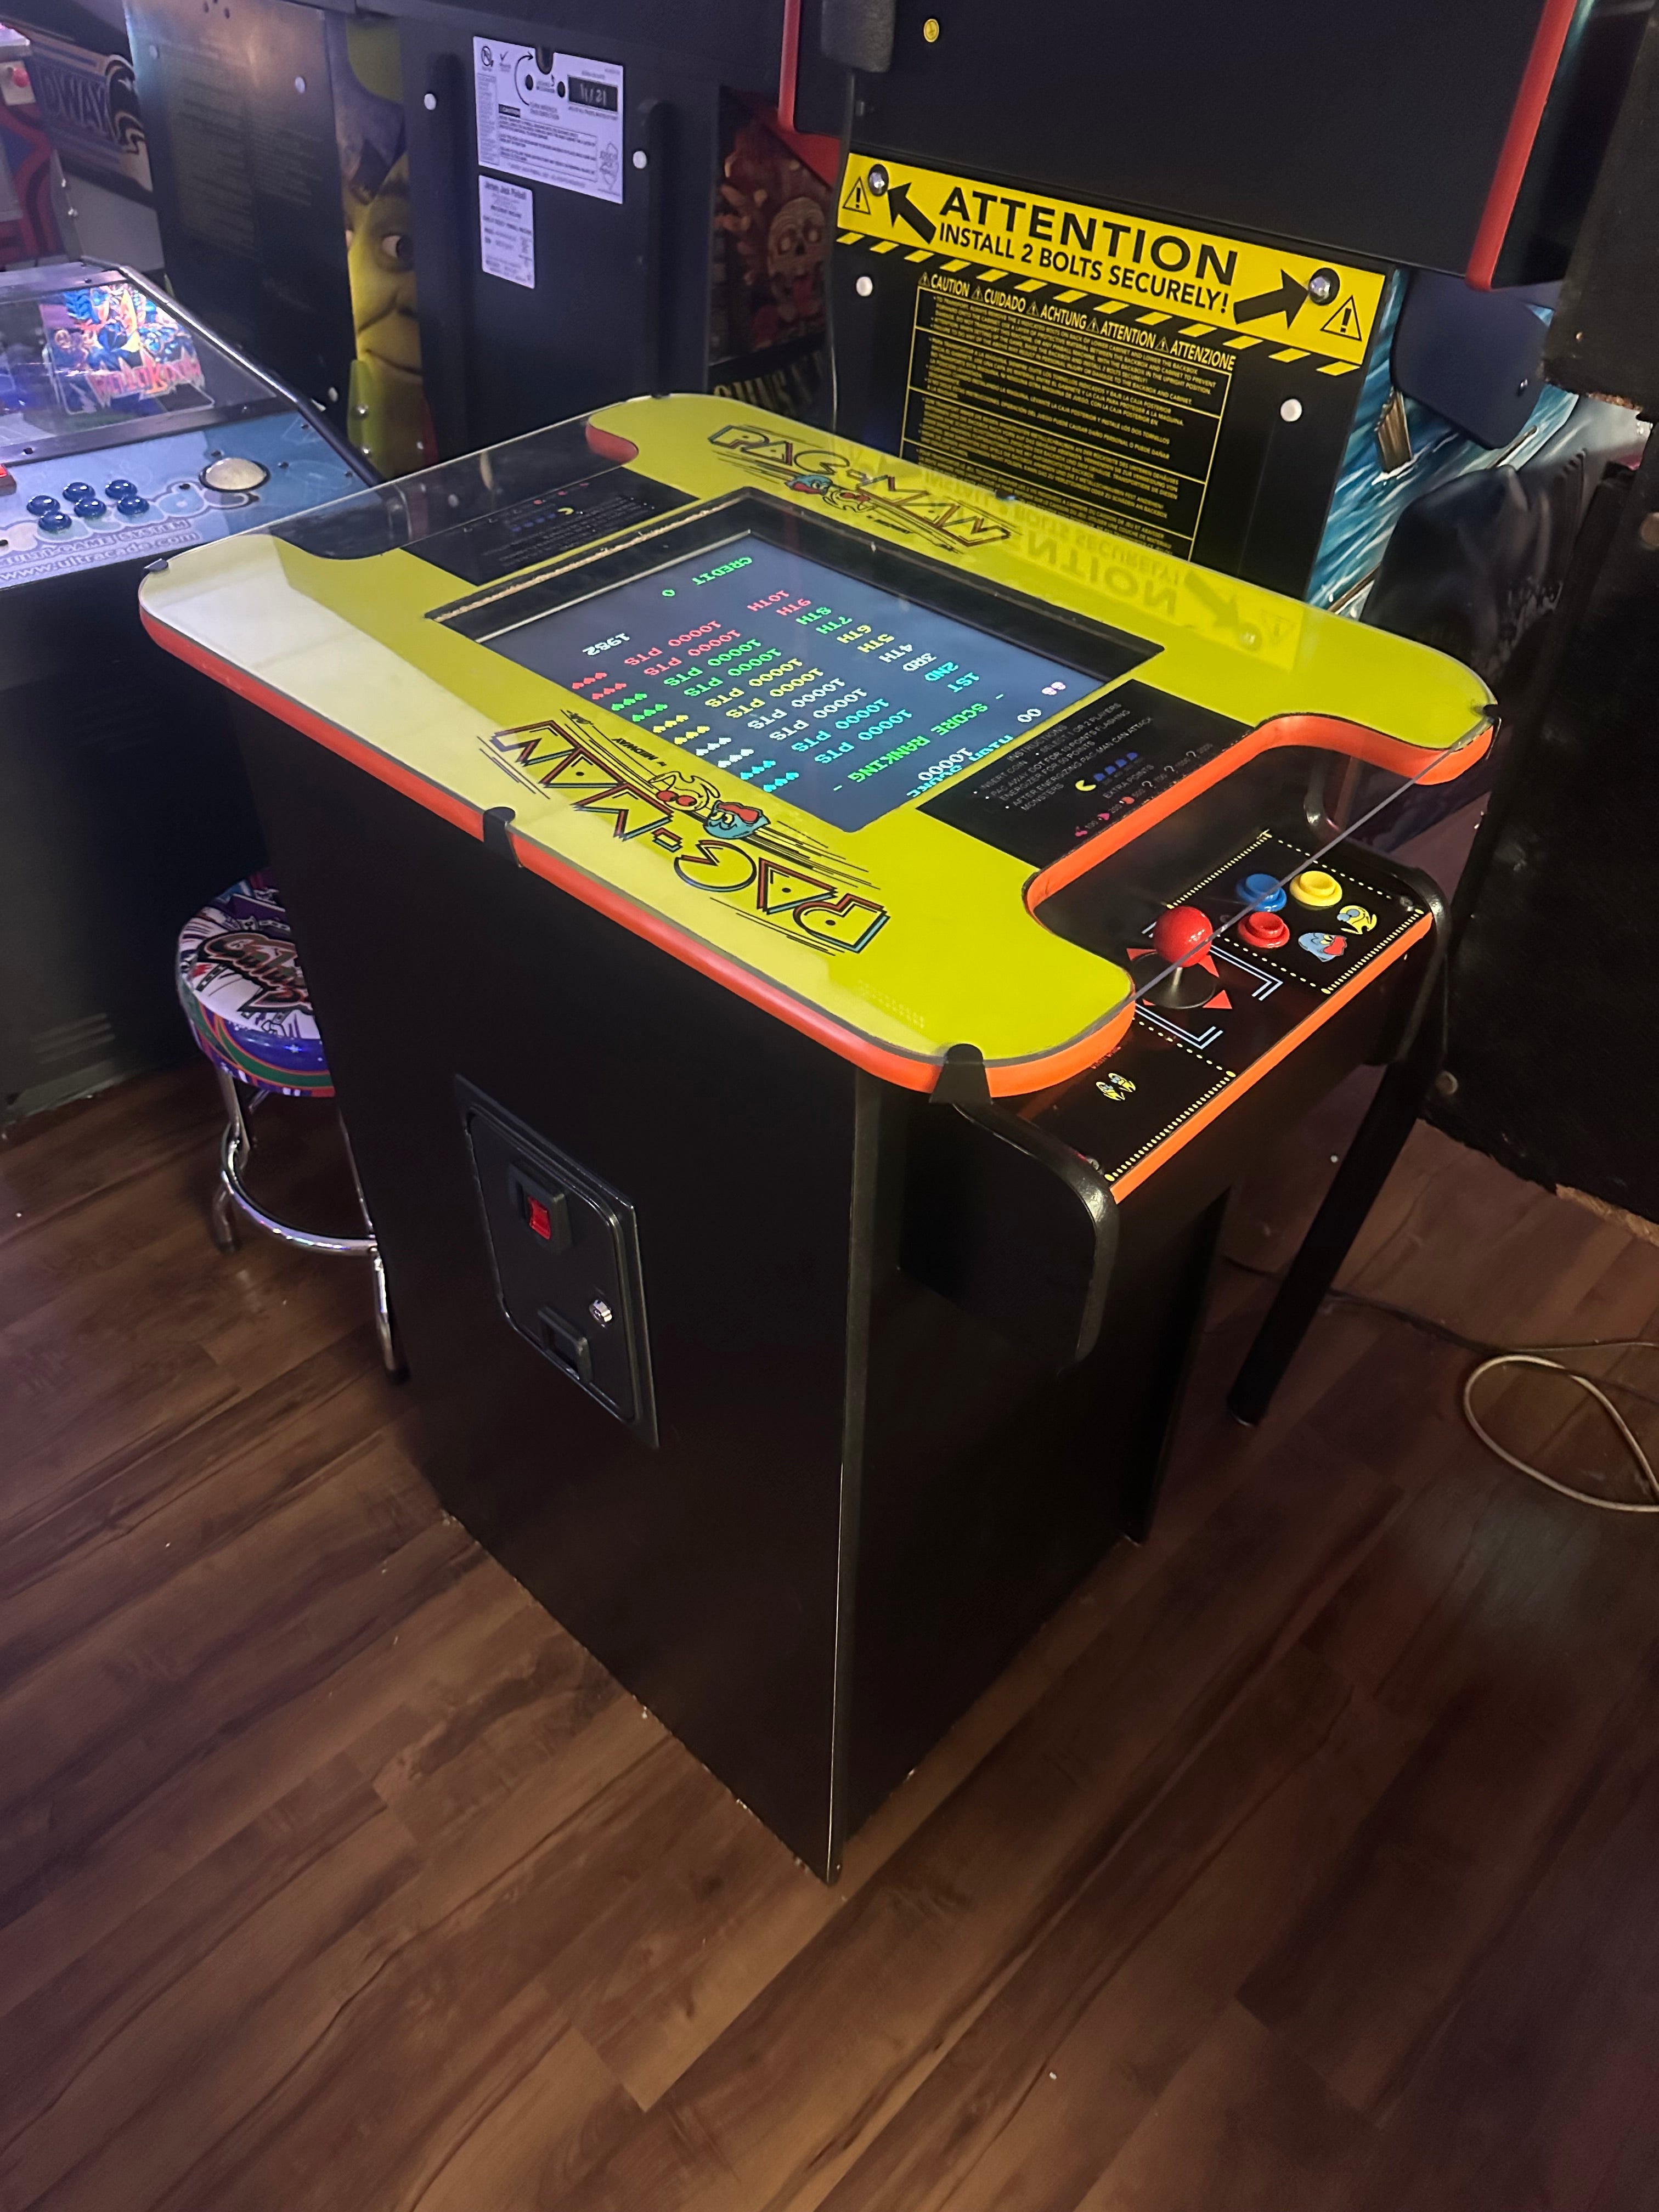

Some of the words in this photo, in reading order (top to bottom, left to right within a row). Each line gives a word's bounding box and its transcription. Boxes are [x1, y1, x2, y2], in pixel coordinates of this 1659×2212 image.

[939, 187, 1238, 286] ATTENTION
[939, 223, 1014, 259] INSTALL
[1021, 243, 1033, 263] 2
[1039, 248, 1103, 281] BOLTS
[1107, 264, 1229, 314] SECURELY!
[930, 273, 970, 297] CAUTION
[984, 288, 1026, 313] CUIDADO
[1040, 303, 1087, 330] ACHTUNG
[1100, 320, 1156, 349] ATTENTION
[1170, 340, 1236, 372] ATTENZIONE
[708, 424, 1012, 547] PAC-MAN
[692, 557, 752, 585] CREDIT
[747, 590, 789, 611] 10TH
[776, 599, 811, 616] 9TH
[795, 607, 832, 625] 8TH
[816, 617, 853, 634] 7TH
[582, 633, 630, 656] 1982
[668, 620, 721, 646] 10000
[687, 630, 741, 656] 10000
[837, 625, 871, 644] 6TH
[857, 634, 895, 653] 5TH
[624, 647, 663, 665] PTS
[707, 639, 761, 666] 10000
[727, 648, 781, 676] 10000
[878, 644, 913, 663] 4TH
[902, 653, 937, 672] 3RD
[644, 657, 682, 676] PTS
[663, 667, 703, 686] PTS
[749, 658, 803, 687] 10000
[924, 662, 959, 681] 2ND
[684, 677, 724, 696] PTS
[770, 668, 823, 697] 10000
[791, 678, 845, 708] 10000
[947, 672, 979, 692] 1ST
[704, 687, 744, 707] PTS
[726, 698, 766, 718] PTS
[813, 688, 867, 718] 10000
[747, 708, 787, 729] PTS
[835, 698, 889, 729] 10000
[857, 709, 912, 740] 10000
[930, 703, 988, 736] SCORE
[769, 719, 809, 741] PTS
[791, 730, 832, 752] PTS
[1004, 759, 1028, 773] COIN
[1070, 724, 1087, 732] OR
[1087, 702, 1122, 723] PLAYERS
[1005, 724, 1069, 761] INSTRUCTIONS
[611, 737, 659, 761] MIDWAY
[814, 742, 855, 764] PTS
[847, 736, 930, 783] RANKING
[989, 785, 1010, 797] PAC
[1026, 761, 1047, 772] DOT
[1043, 751, 1064, 763] FOR
[1067, 729, 1099, 747] POINTS
[1093, 709, 1132, 731] FLASHING
[1010, 788, 1040, 806] AFTER
[1034, 761, 1084, 791] ENERGIZING
[1110, 731, 1130, 743] CAN
[1125, 716, 1155, 733] ATTACK
[918, 747, 973, 781] 10000
[998, 772, 1046, 801] ENERGIZER
[1040, 763, 1062, 774] FOR
[1056, 756, 1071, 764] 50
[1065, 740, 1097, 759] POINTS
[1101, 781, 1131, 799] EXTRA
[1125, 764, 1156, 783] POINTS
[1019, 782, 1065, 810] MONSTERS
[491, 720, 891, 954] PAC-MAN
